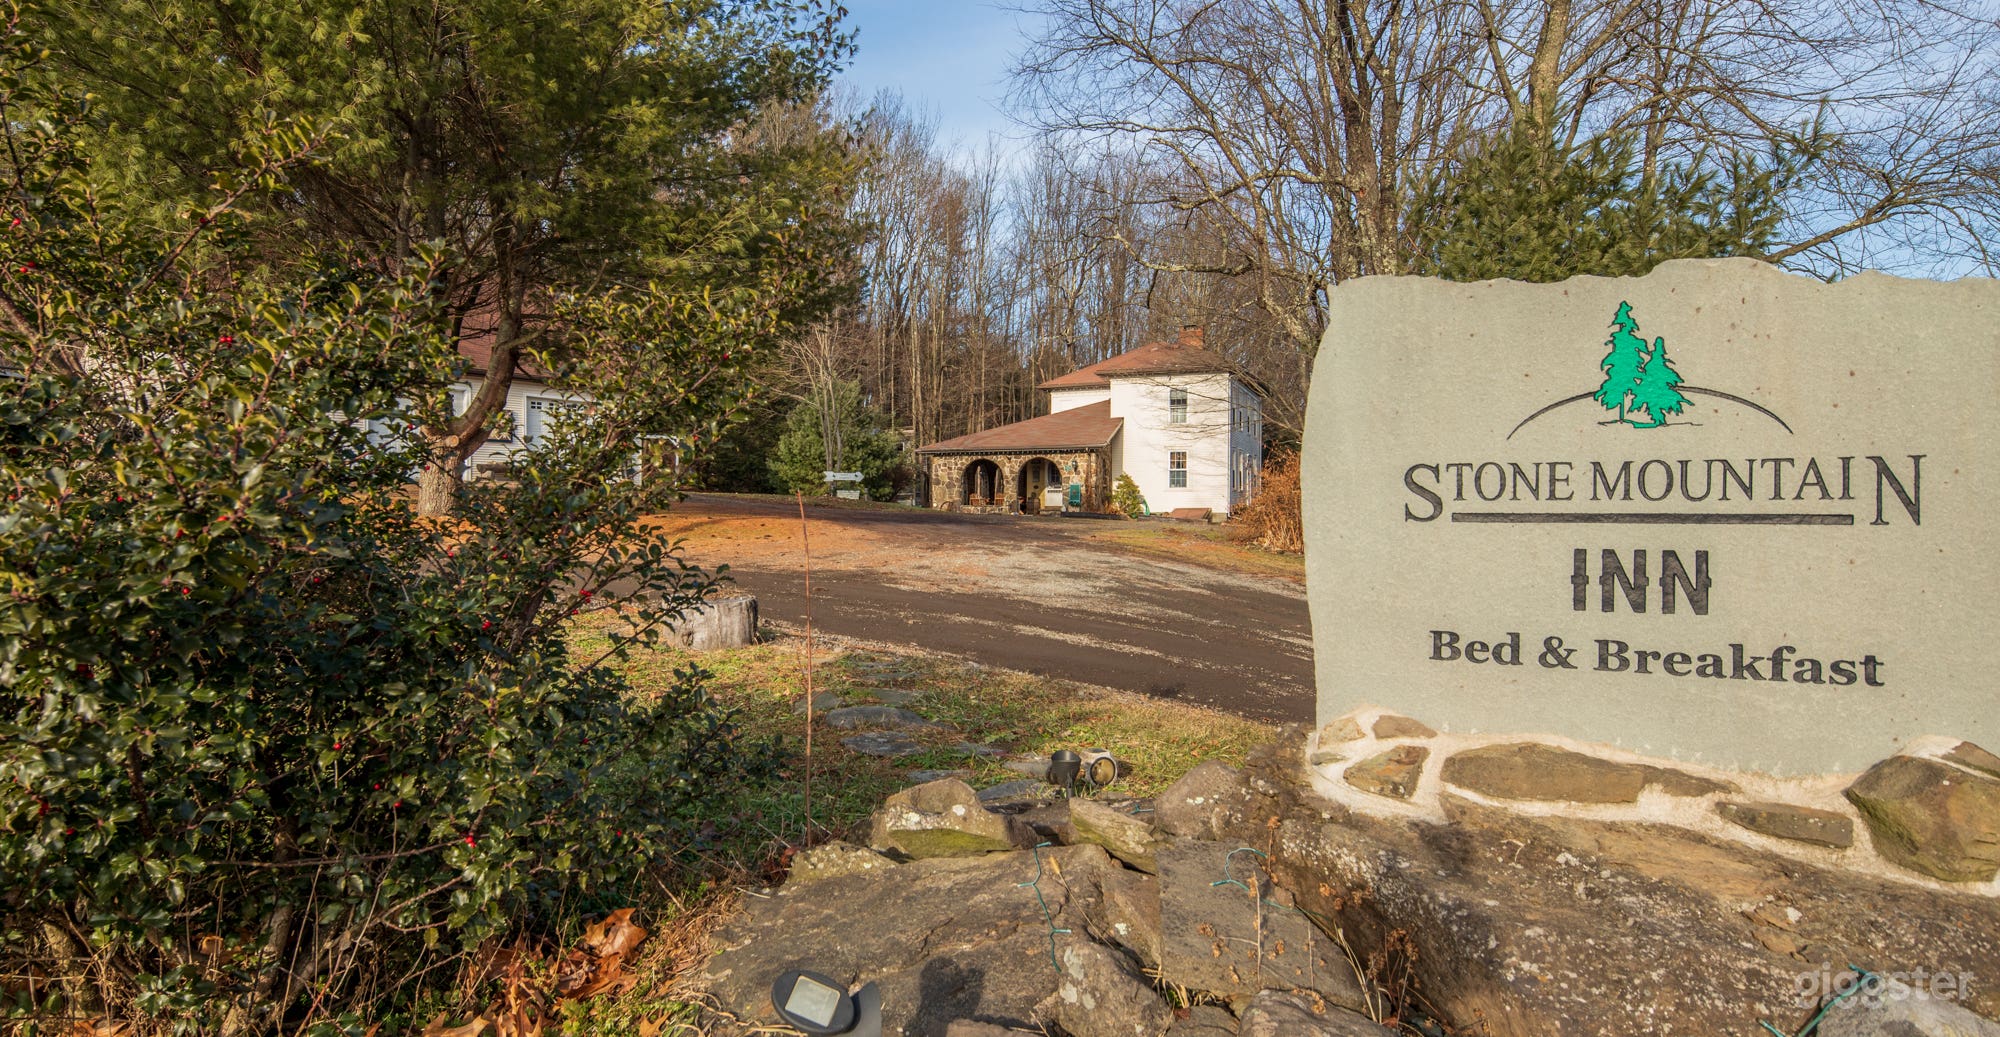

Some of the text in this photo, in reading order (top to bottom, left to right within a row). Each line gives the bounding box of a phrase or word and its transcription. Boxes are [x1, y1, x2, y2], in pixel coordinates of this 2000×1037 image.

[1403, 454, 1928, 526] STONE MOUNTAIN
[1570, 548, 1712, 616] INN
[1428, 630, 1886, 688] Bed & Breakfast
